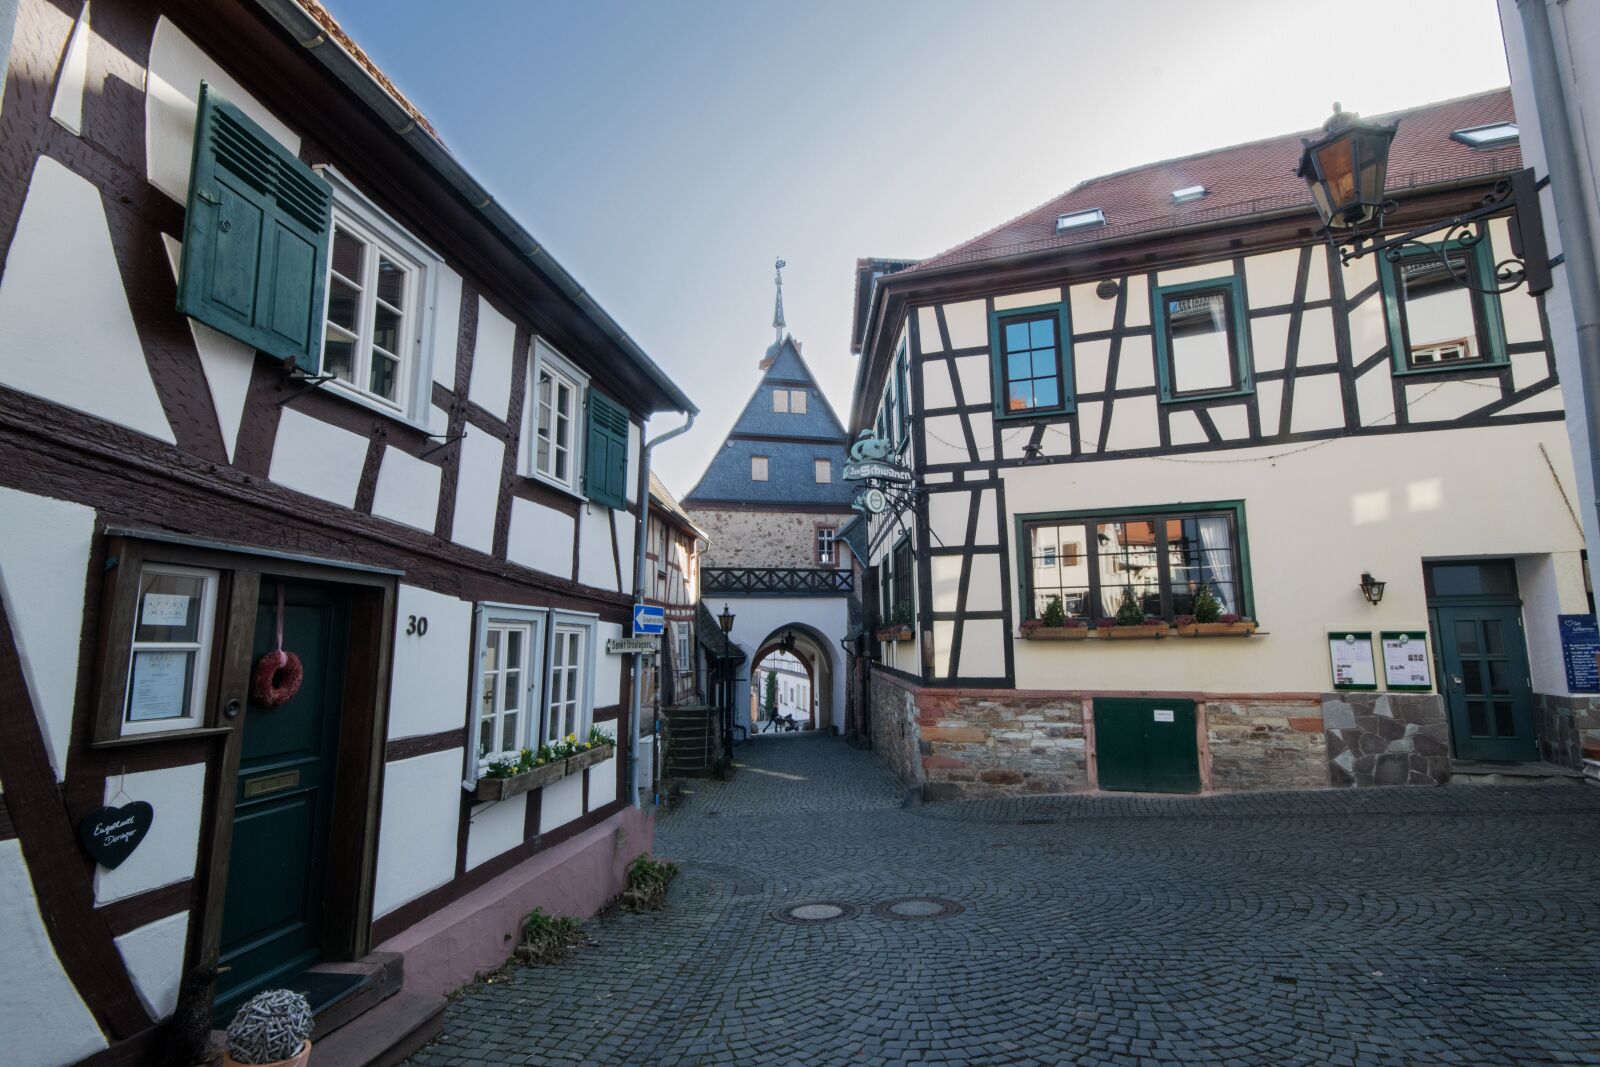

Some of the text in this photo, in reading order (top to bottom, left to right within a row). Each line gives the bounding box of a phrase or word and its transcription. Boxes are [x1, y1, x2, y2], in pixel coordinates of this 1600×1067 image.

[860, 464, 912, 480] Schwanen
[406, 614, 429, 638] 30
[611, 640, 656, 652] Sankt Ursulagass
